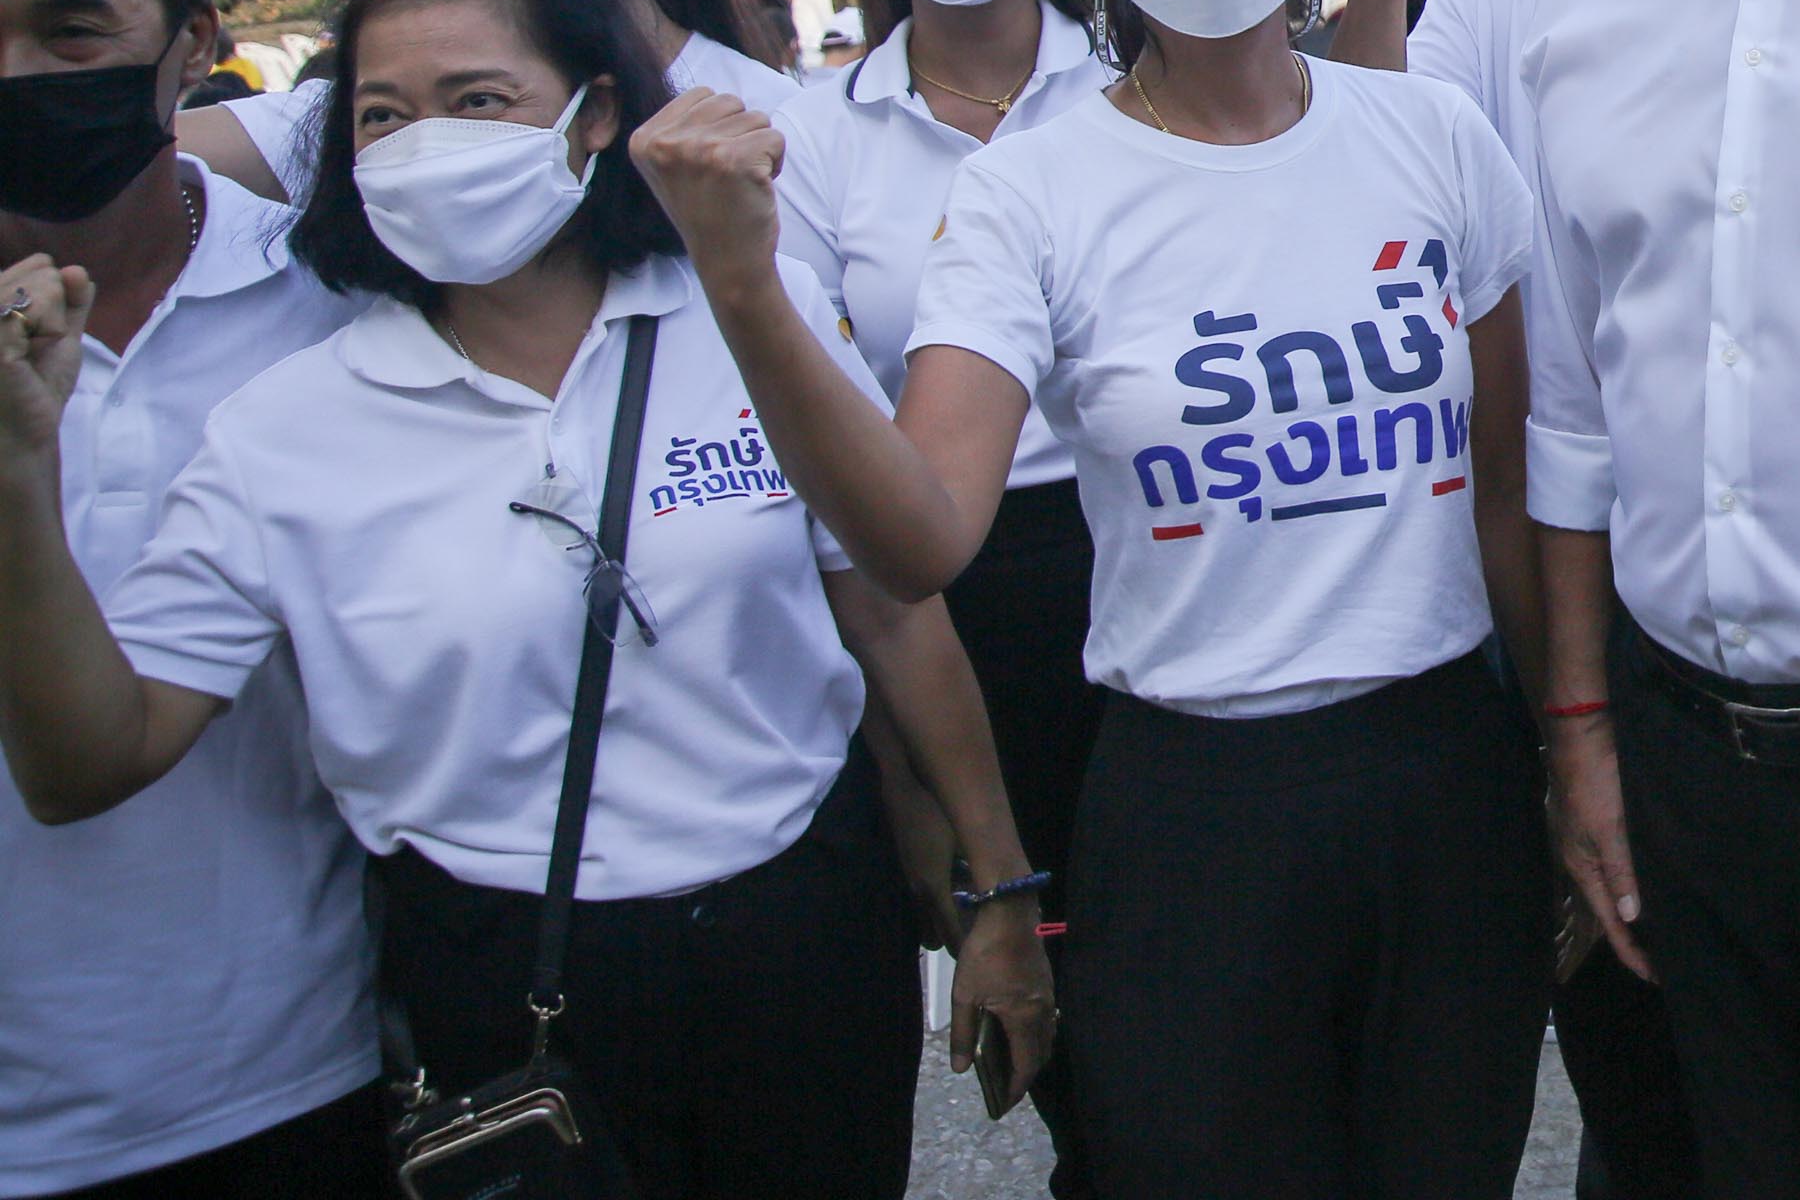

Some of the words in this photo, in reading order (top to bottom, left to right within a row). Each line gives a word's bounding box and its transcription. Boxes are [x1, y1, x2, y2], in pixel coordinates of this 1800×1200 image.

[1174, 281, 1445, 426] รักษ์
[665, 427, 765, 477] รักษ์
[649, 468, 787, 509] กรุงเทพ
